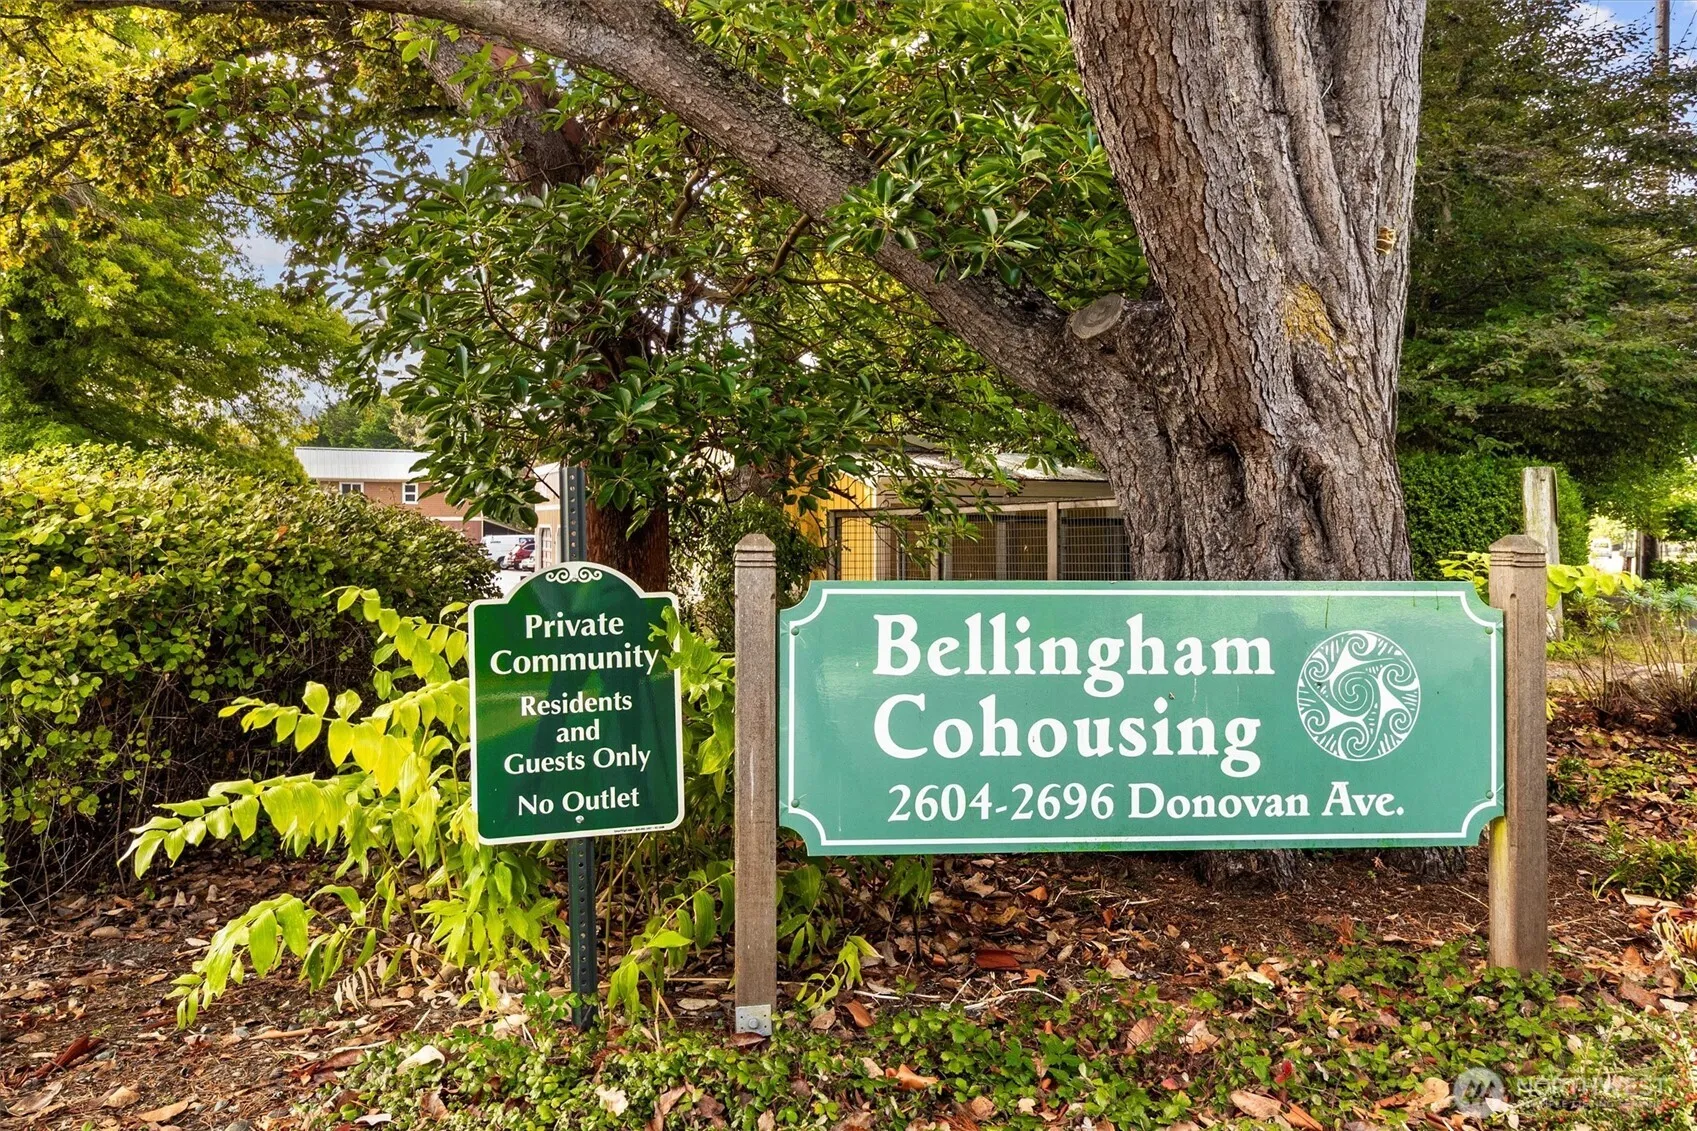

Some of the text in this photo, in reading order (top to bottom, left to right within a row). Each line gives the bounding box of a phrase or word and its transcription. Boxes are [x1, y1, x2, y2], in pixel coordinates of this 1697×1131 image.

[525, 611, 624, 639] Private
[490, 642, 659, 675] Community
[872, 612, 1275, 698] Bellingham
[520, 690, 633, 717] Residents
[556, 718, 600, 743] and
[873, 693, 1261, 778] Cohousing
[503, 743, 651, 775] Guests Only
[518, 786, 640, 816] No Outlet
[887, 781, 1404, 822] 2604-2696 Donovan Ave.
